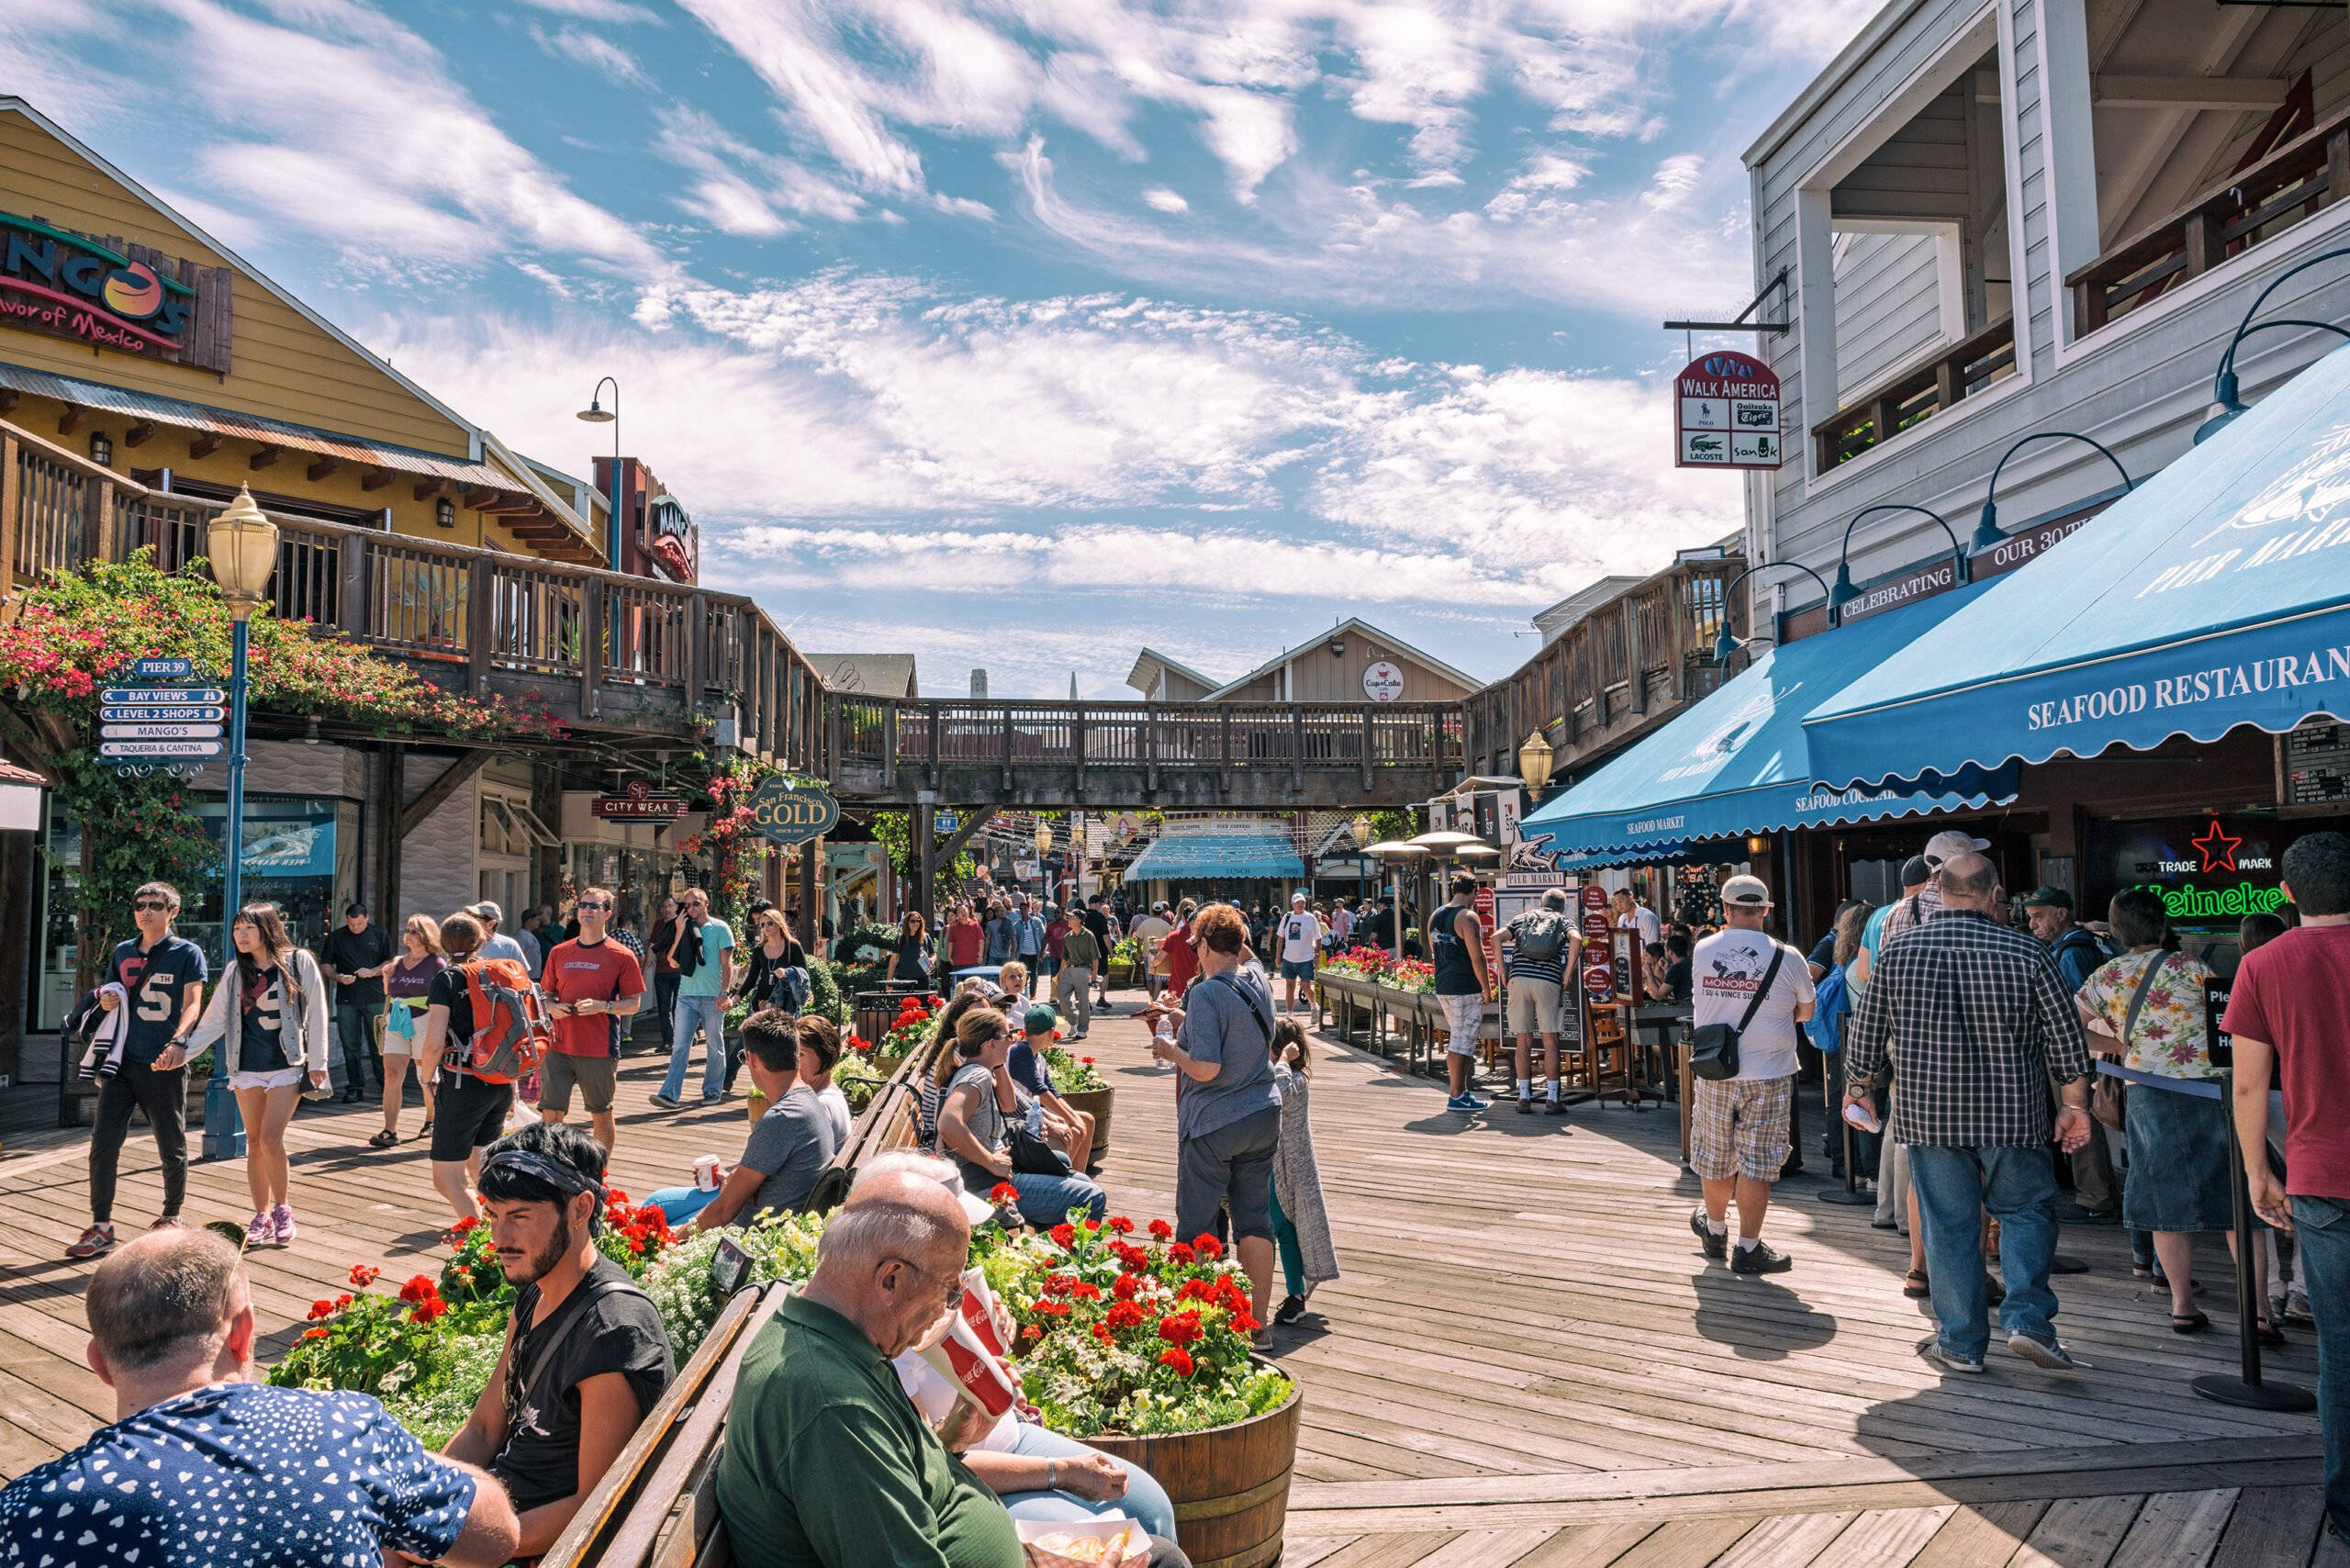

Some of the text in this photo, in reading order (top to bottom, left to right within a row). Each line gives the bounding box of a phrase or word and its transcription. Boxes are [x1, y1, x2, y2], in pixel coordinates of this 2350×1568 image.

[40, 307, 66, 326] of
[72, 314, 144, 351] Mexico
[1682, 379, 1777, 398] WALK AMERICA
[1995, 538, 2035, 566] OUR
[1843, 567, 1953, 619] CELEBRATING
[142, 662, 185, 673] PIER 39
[129, 691, 188, 701] BAY VIEWS
[2028, 646, 2350, 732] SEAFOOD RESTAURAN
[117, 709, 200, 719] LEVEL 2 SHOPS
[138, 726, 188, 735] MANGO'S
[120, 745, 202, 753] TAQUERIA & CANTINA
[759, 791, 822, 806] San Francisco
[1796, 792, 1841, 812] SEAFOOD
[605, 802, 669, 812] CITY WEAR
[754, 803, 826, 824] GOLD
[1627, 815, 1685, 834] SEAFOOD MARKET
[2158, 858, 2272, 872] TRADE MARK
[1509, 874, 1562, 884] PIER MARKET
[2135, 881, 2290, 917] eineke
[1705, 978, 1762, 991] MONOPOL
[1720, 991, 1741, 999] VINCE
